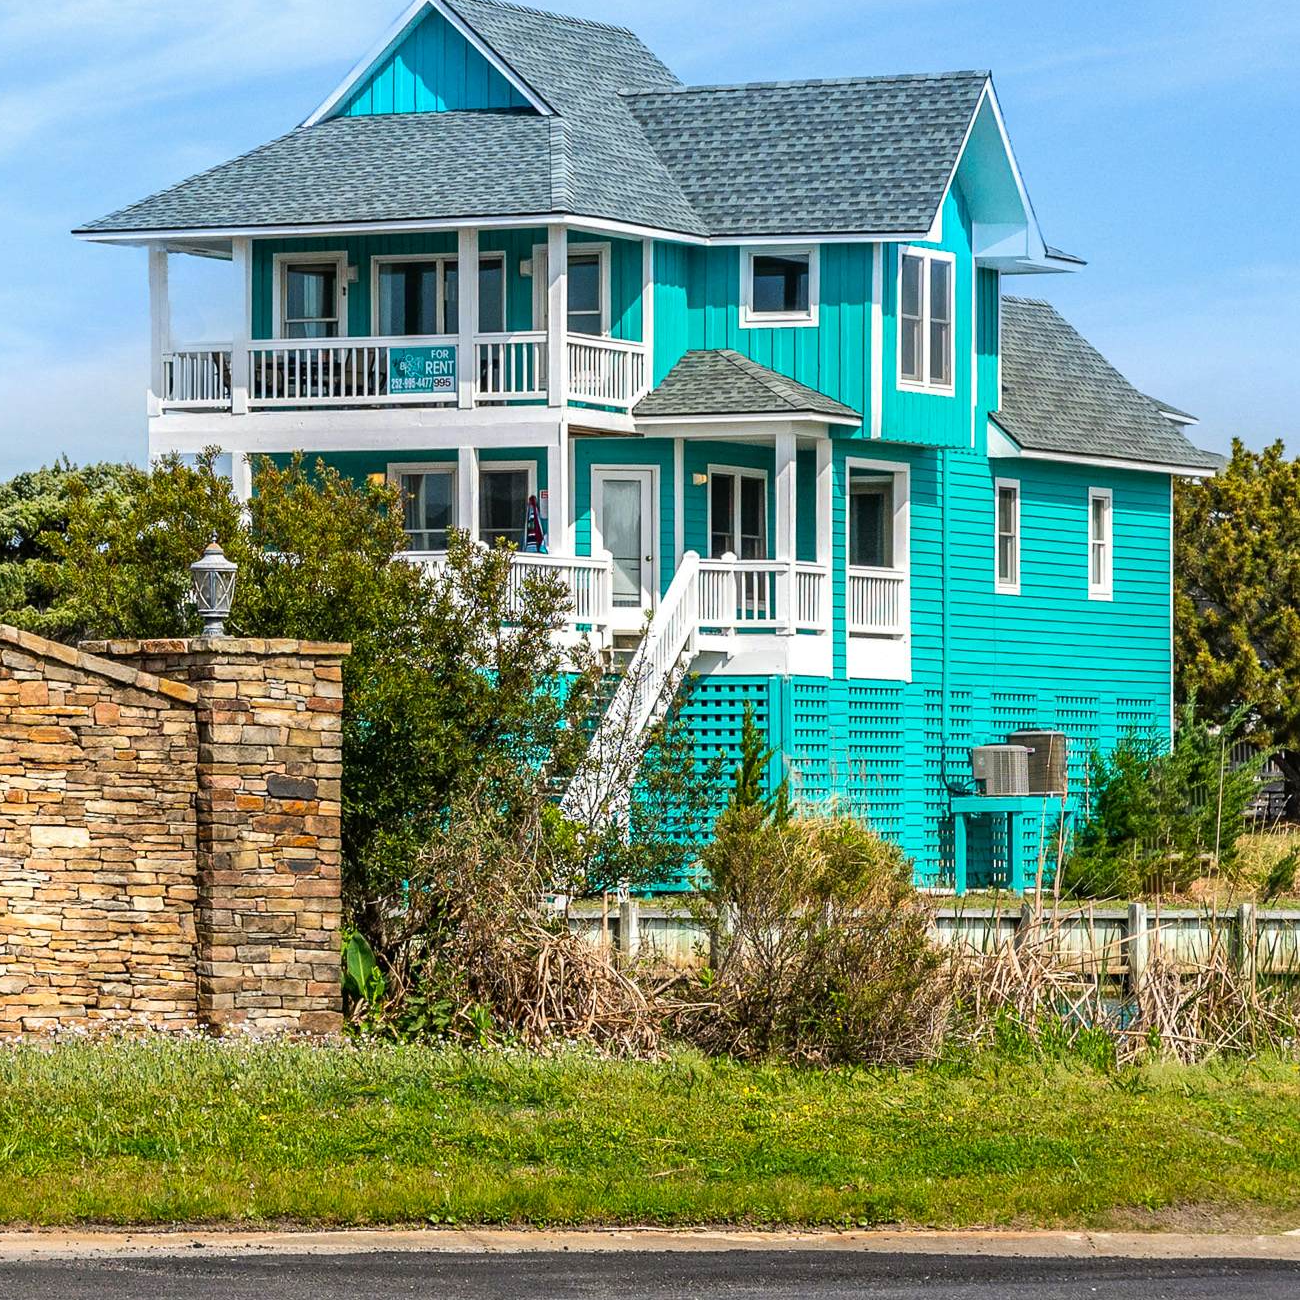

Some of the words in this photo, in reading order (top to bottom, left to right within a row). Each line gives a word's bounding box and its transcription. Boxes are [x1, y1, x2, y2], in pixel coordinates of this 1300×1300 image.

[431, 349, 449, 359] FOR
[425, 361, 455, 374] RENT
[433, 378, 451, 387] 995
